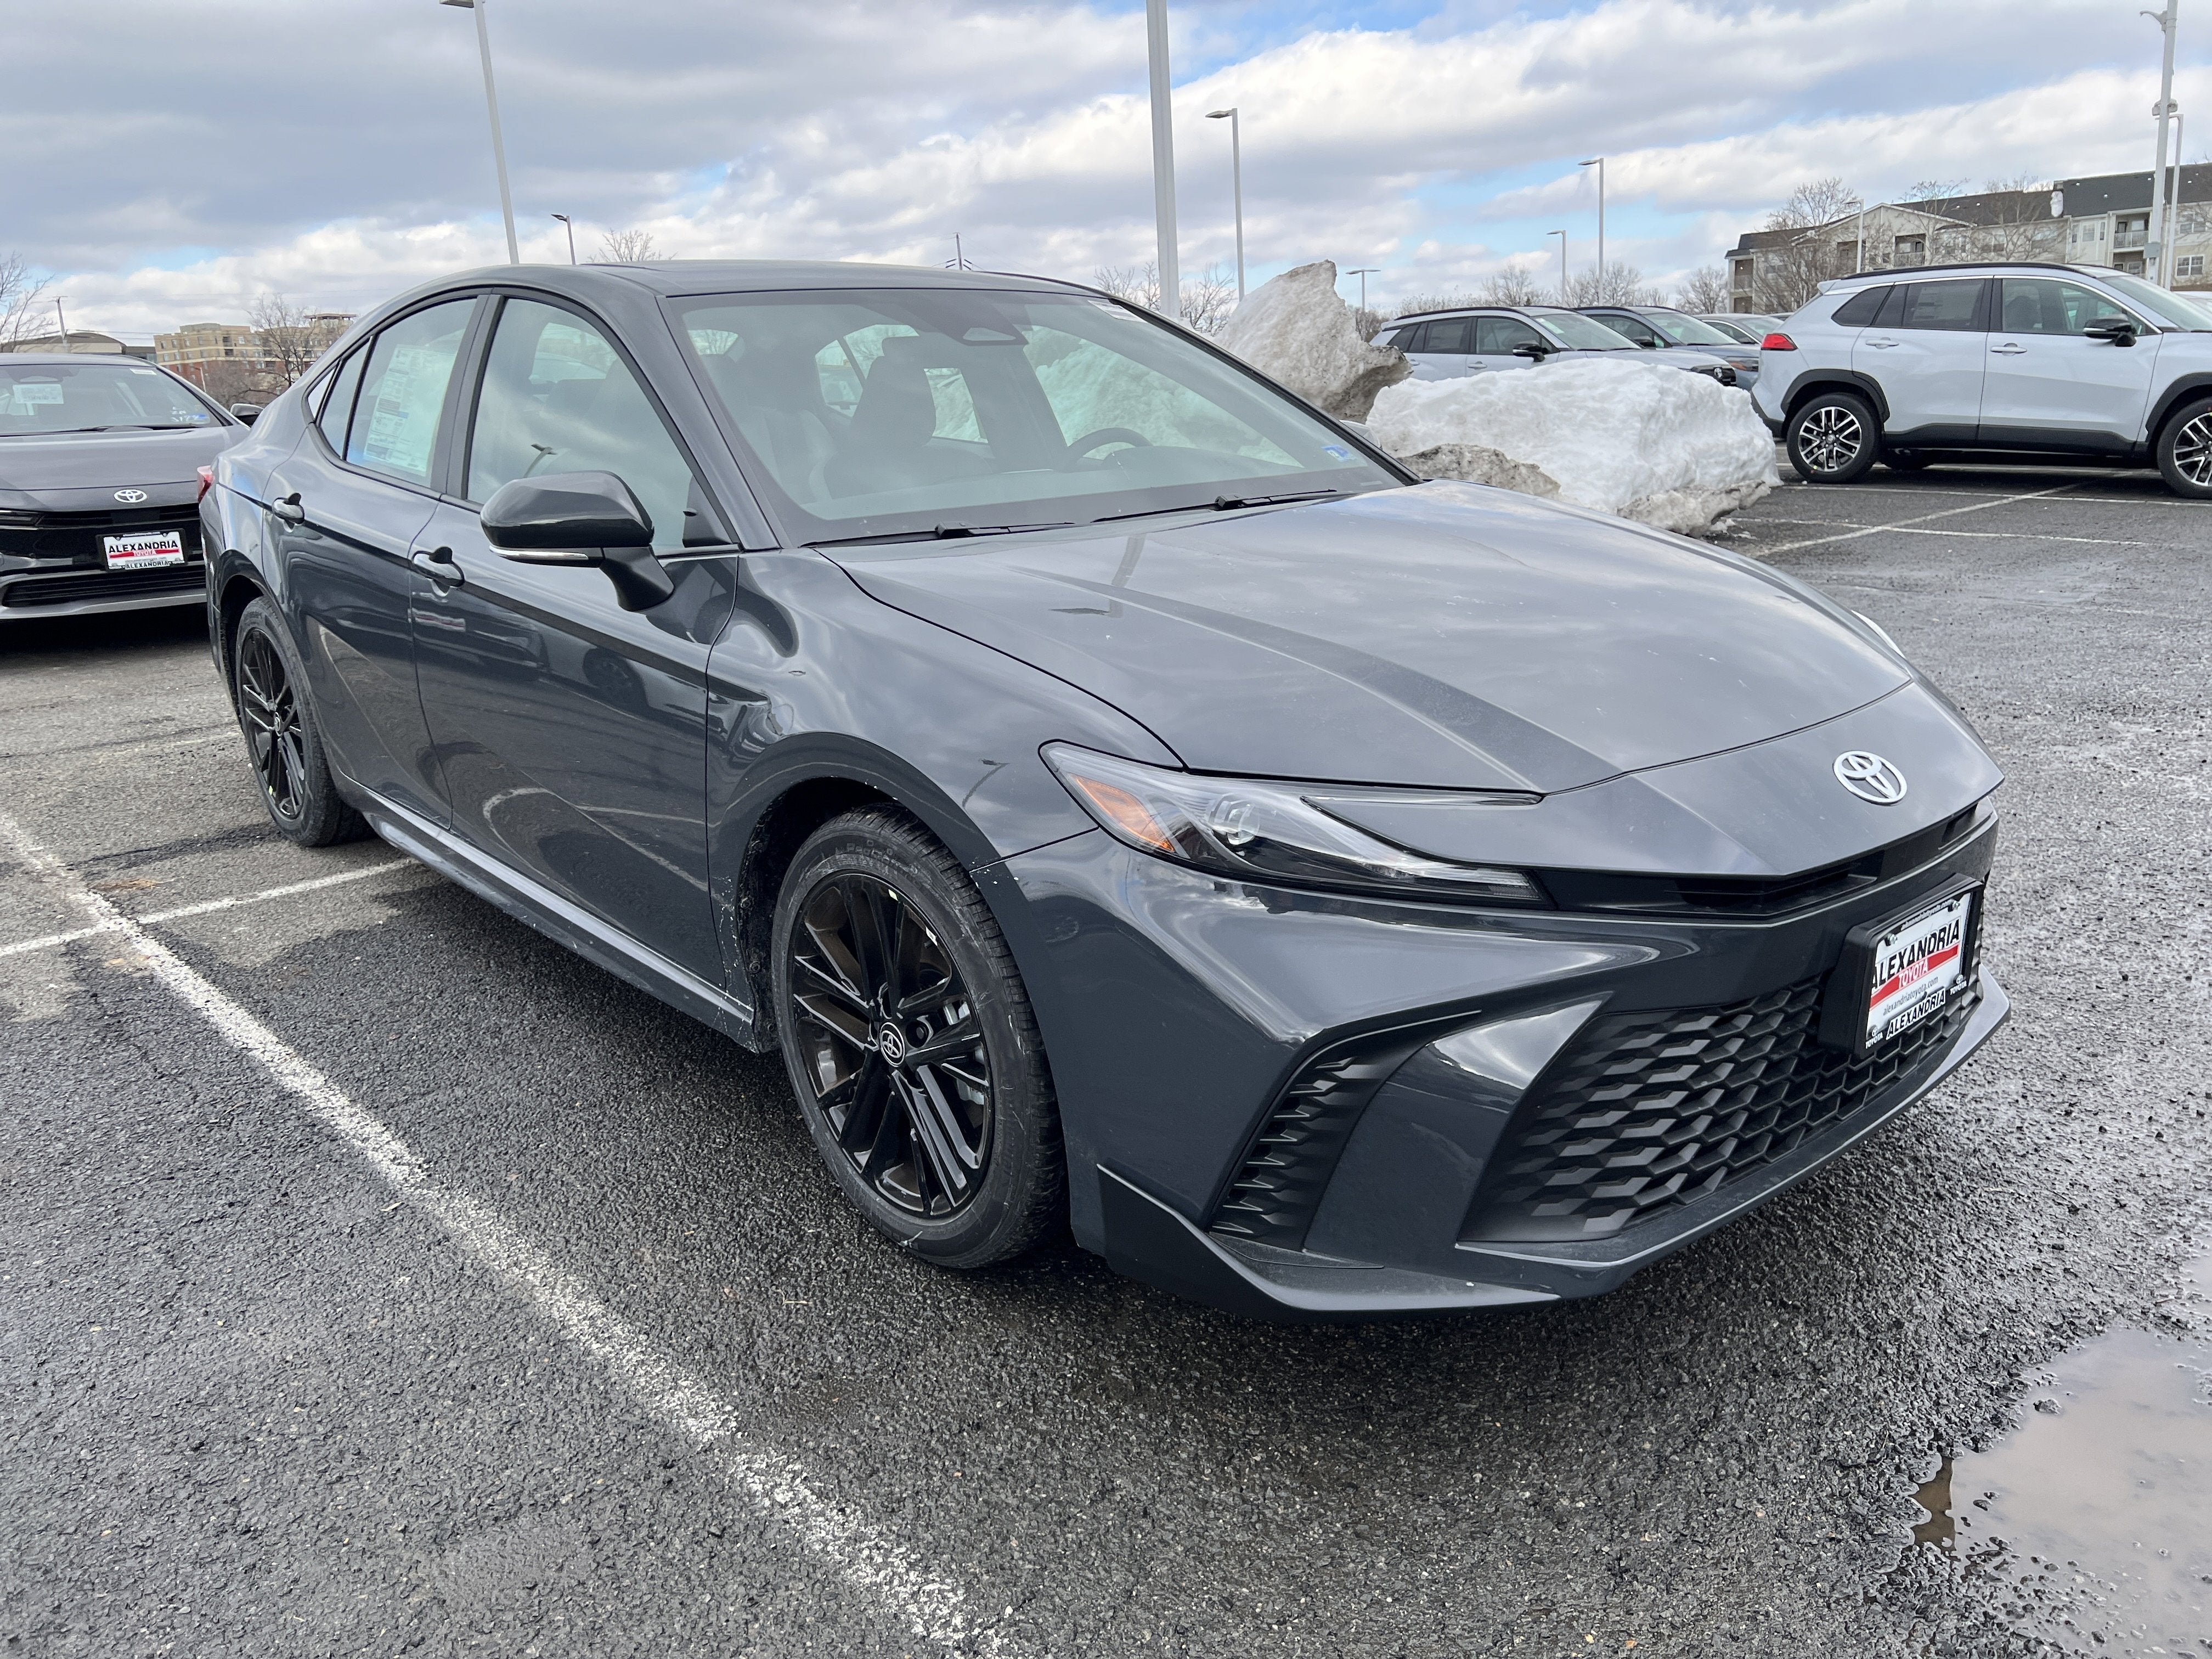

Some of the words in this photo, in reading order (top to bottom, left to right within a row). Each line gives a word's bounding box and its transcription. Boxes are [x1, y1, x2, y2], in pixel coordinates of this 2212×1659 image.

[109, 540, 178, 553] ALEXANDRIA
[126, 561, 168, 569] ALEXANDRIA
[1871, 919, 1960, 988] ALEXANDRIA
[1899, 958, 1928, 988] TOYOTA
[1950, 980, 1967, 995] TOYOTA
[1887, 989, 1945, 1039] ALEXANDRIA
[1865, 1032, 1883, 1049] TOYOTA
